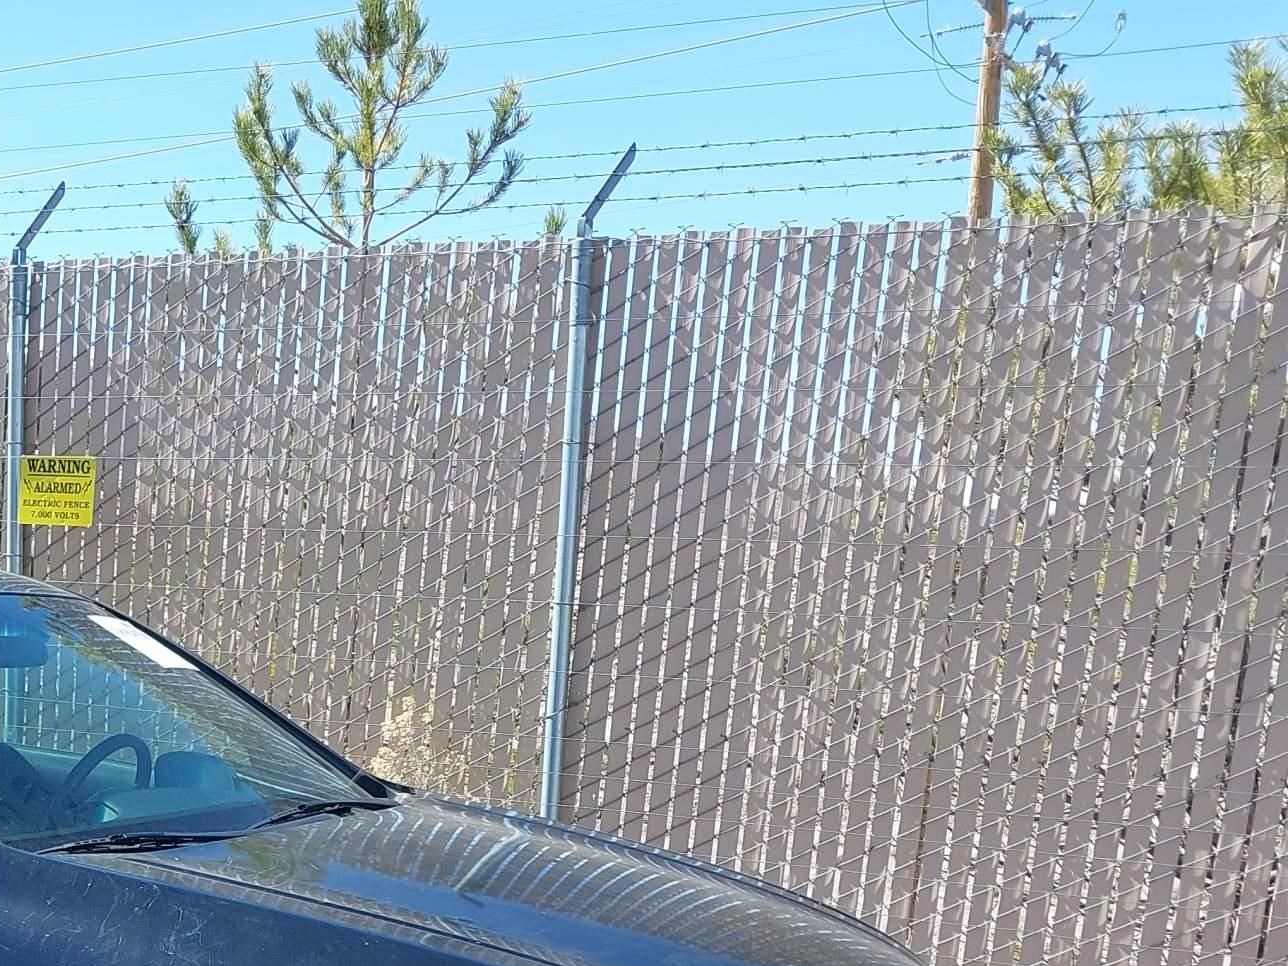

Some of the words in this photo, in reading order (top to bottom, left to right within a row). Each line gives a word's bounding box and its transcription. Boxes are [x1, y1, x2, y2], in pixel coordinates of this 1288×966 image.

[27, 459, 91, 474] WARNING
[34, 481, 82, 494] ALARMED
[23, 499, 61, 508] ELECTRIC
[64, 501, 90, 509] FENCE
[55, 512, 80, 520] VOLTS
